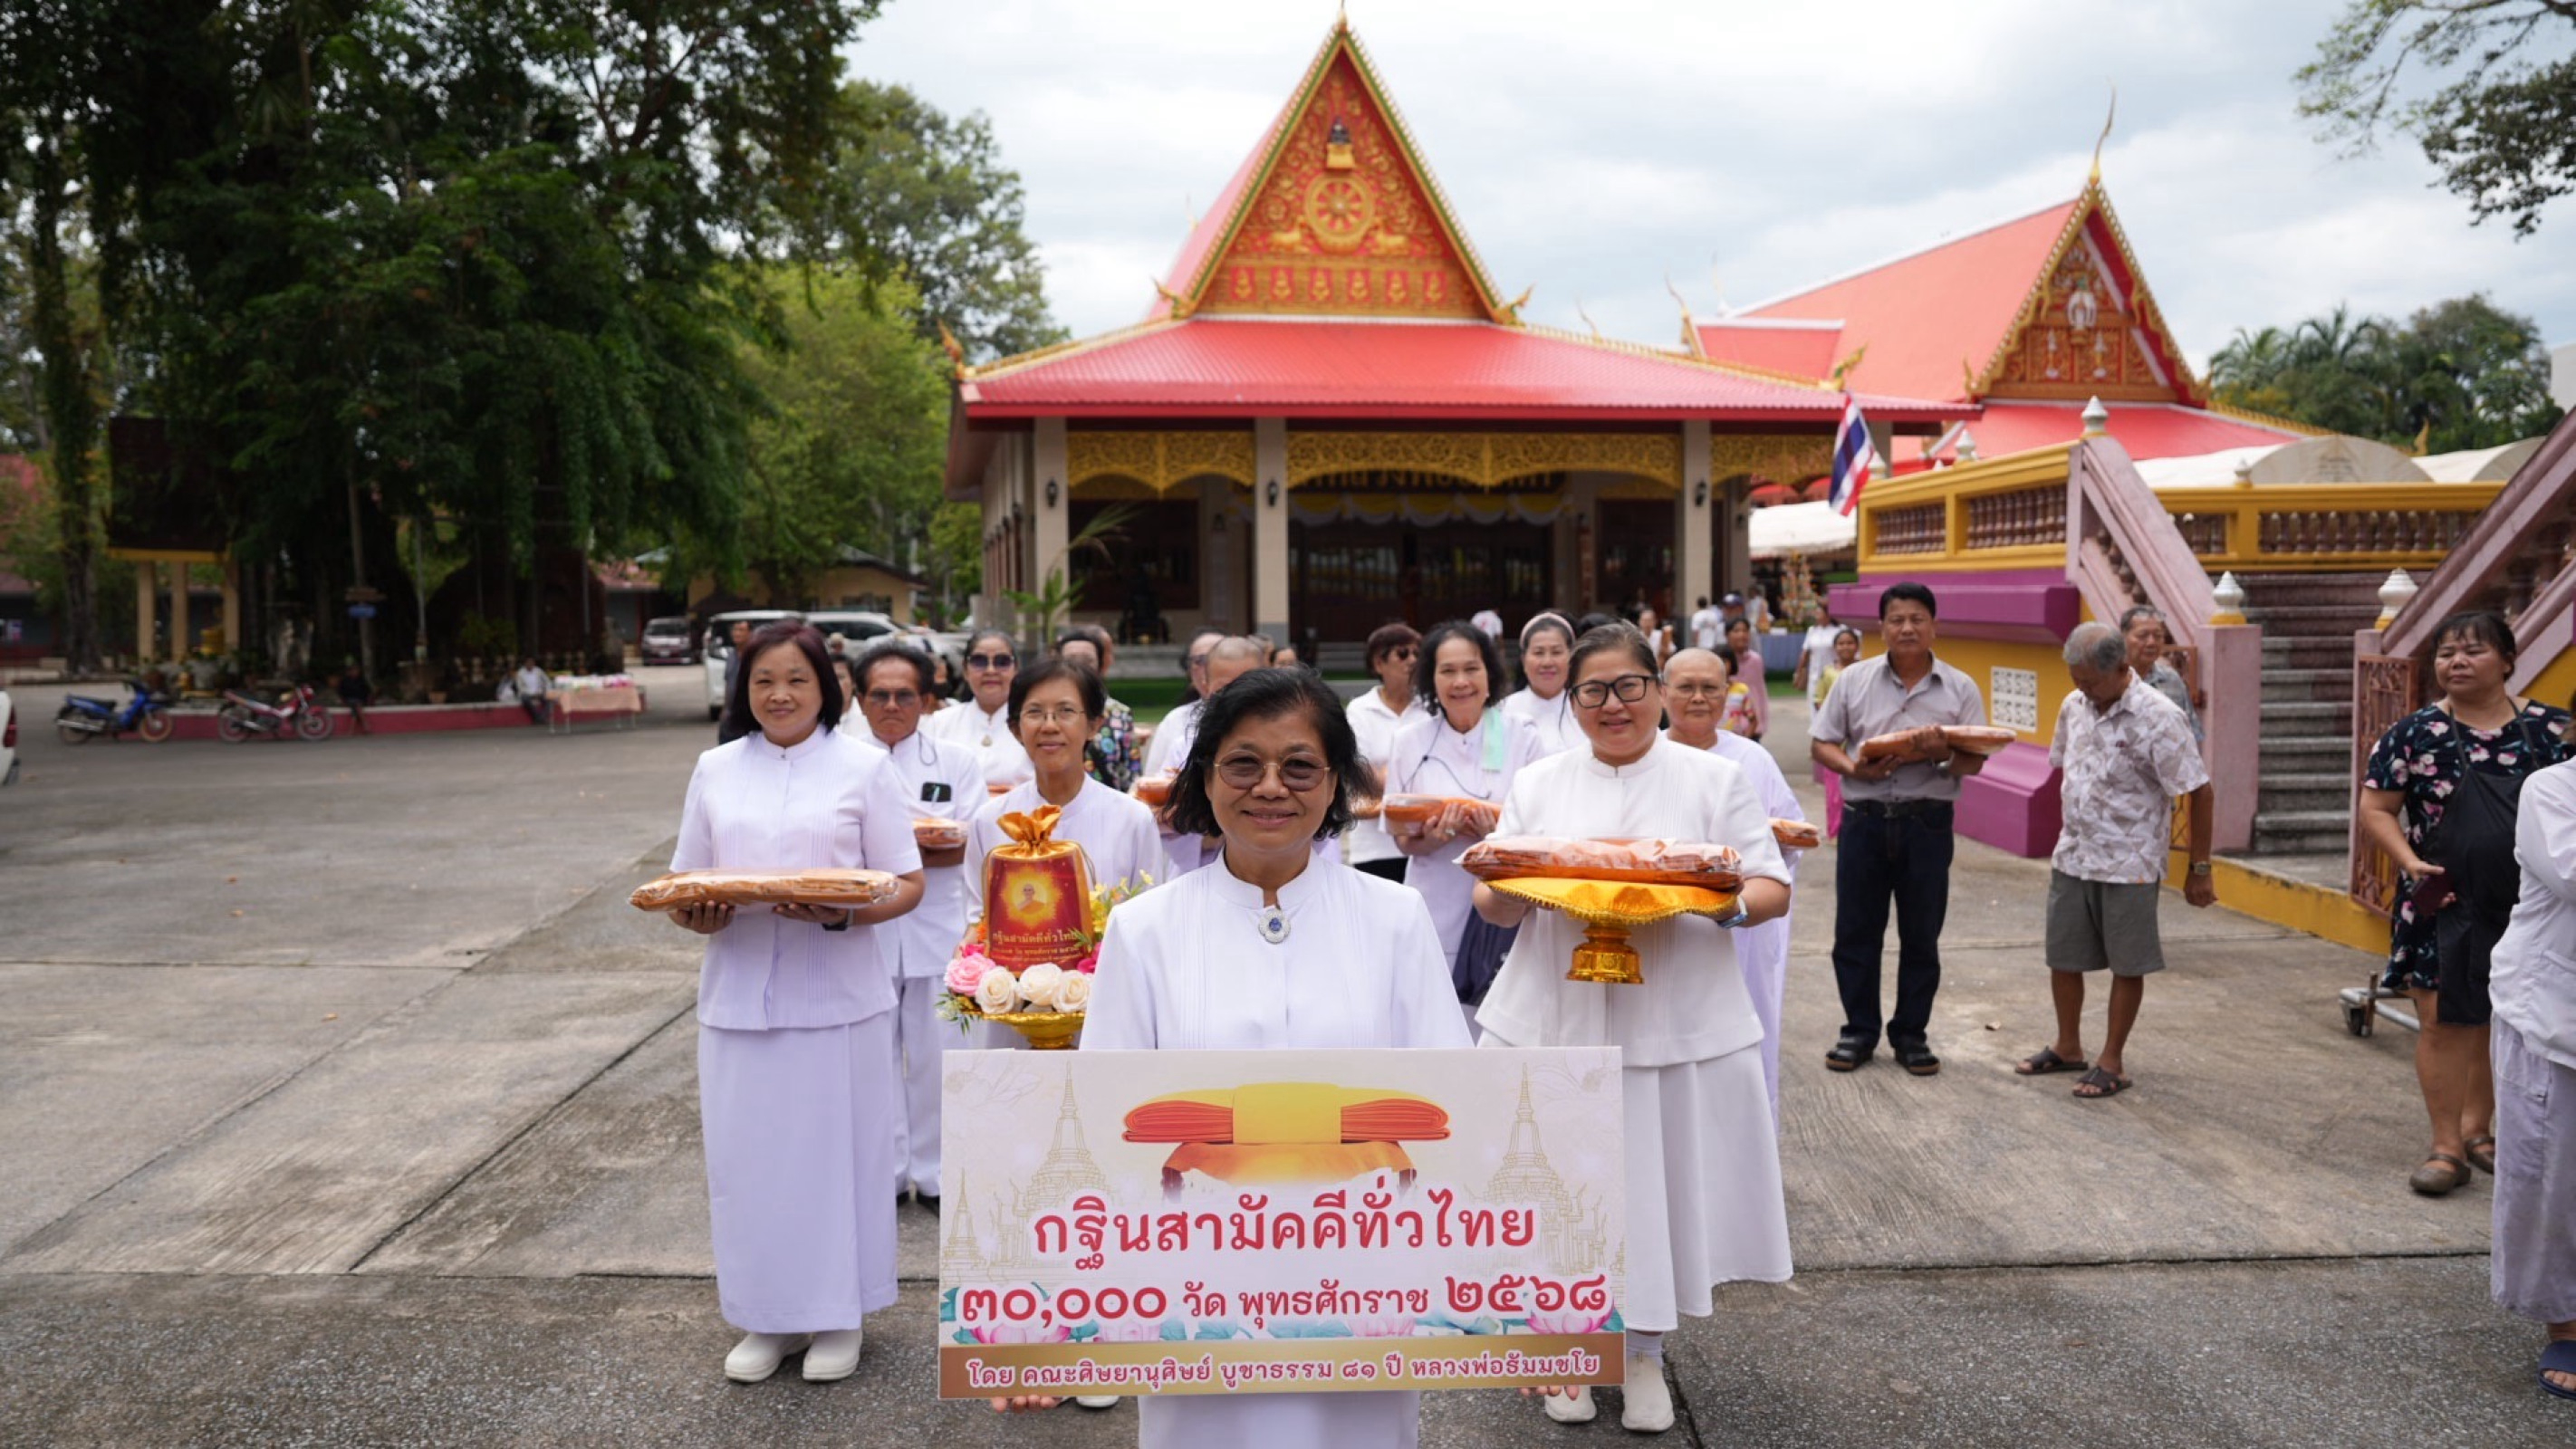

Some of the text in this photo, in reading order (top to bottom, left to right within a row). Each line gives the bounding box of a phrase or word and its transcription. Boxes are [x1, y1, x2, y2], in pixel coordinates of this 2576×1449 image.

[1033, 1176, 1534, 1271] กฐินสามัคคีทั่วไทย
[963, 1273, 1607, 1329] ๓๐,๐๐๐ วัด พุทธศักราช ๒๕๖๘
[968, 1361, 1013, 1386] โดย
[1024, 1355, 1211, 1389] คณะศิษยานุศิษย์
[1341, 1362, 1376, 1378] ๘๑
[1385, 1354, 1402, 1377] ปี
[1411, 1350, 1599, 1377] หลวงพ่อธัมมชโย
